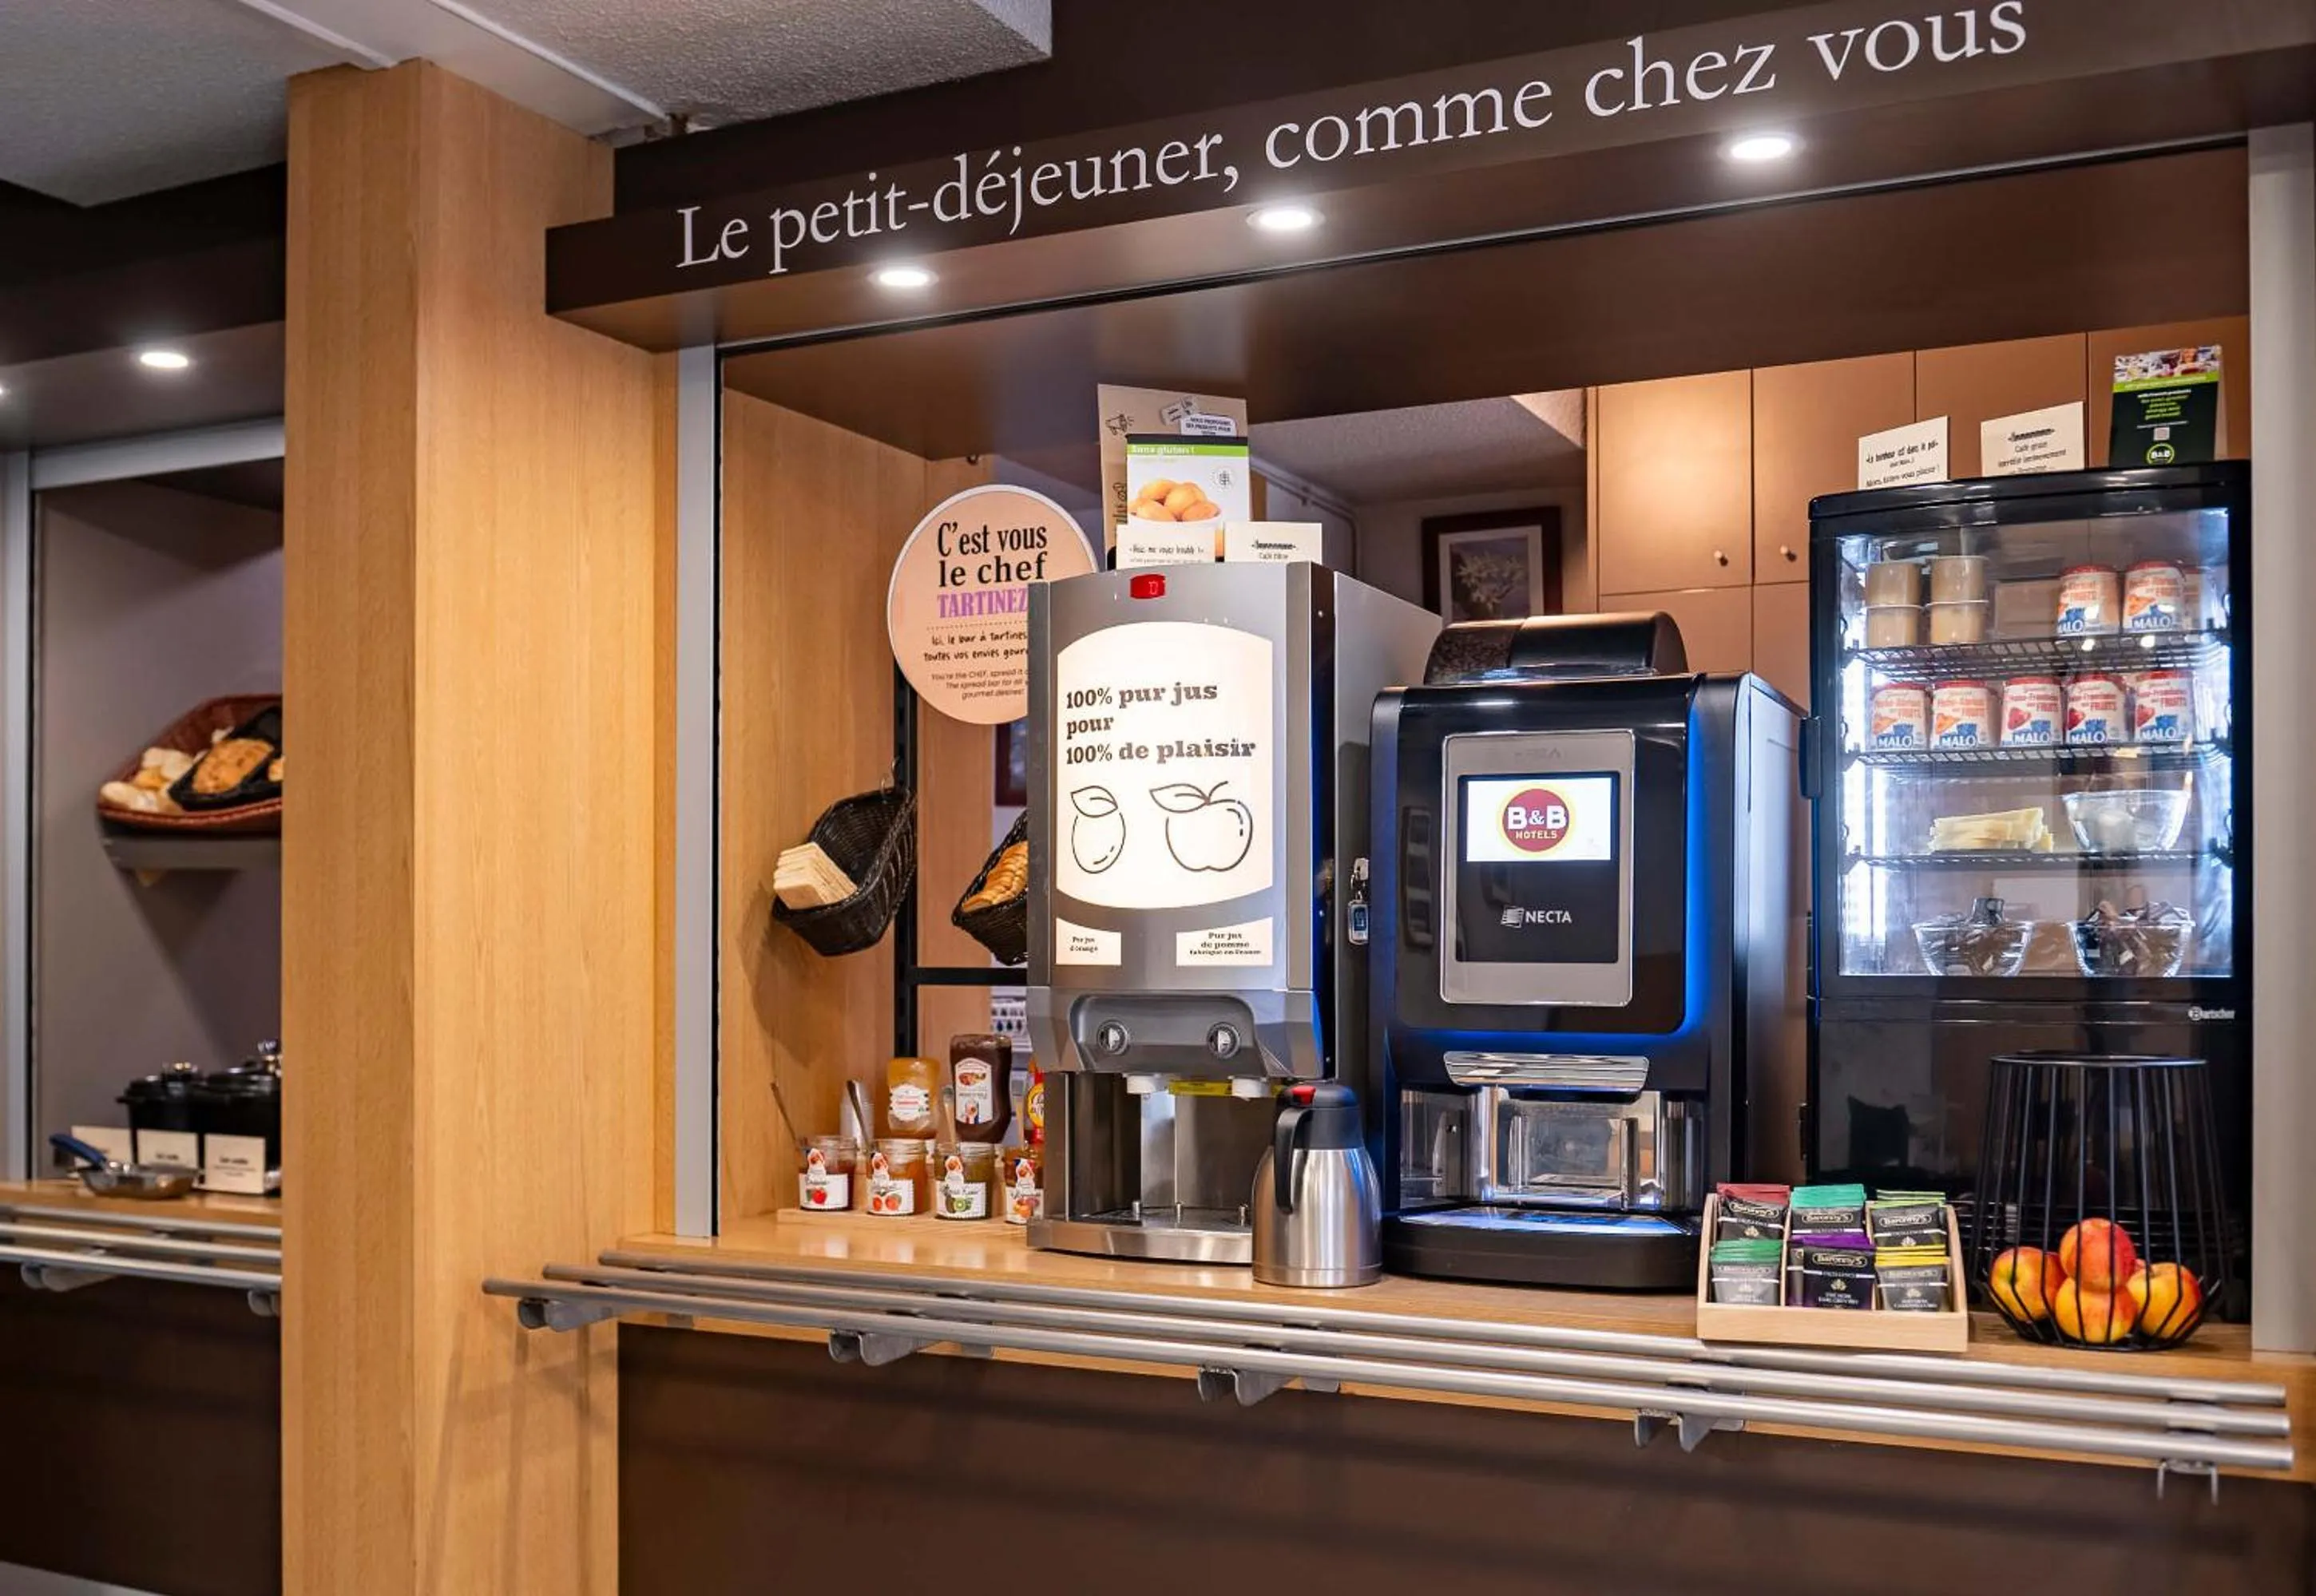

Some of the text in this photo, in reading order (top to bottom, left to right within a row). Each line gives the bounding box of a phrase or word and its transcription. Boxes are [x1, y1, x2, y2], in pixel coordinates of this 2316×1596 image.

[676, 1, 2027, 275] Le petit-déjeuner, comme chez vous
[997, 525, 1048, 553] vous
[938, 551, 1049, 588] le chef
[2133, 616, 2171, 630] MALO
[923, 651, 950, 662] toutes
[954, 650, 970, 660] vos
[972, 648, 1000, 659] envies
[1065, 681, 1219, 710] 100% pur jus
[1065, 715, 1115, 740] pour
[1878, 735, 1913, 748] MALO
[1941, 735, 1977, 747] MALO
[2013, 730, 2051, 744] MALO
[2070, 730, 2107, 744] MALO
[1065, 738, 1257, 765] 100% de plaisir
[1507, 805, 1568, 830] B&B
[1514, 830, 1558, 840] HOTELS
[1525, 910, 1572, 924] NECTA
[1227, 932, 1243, 941] jus
